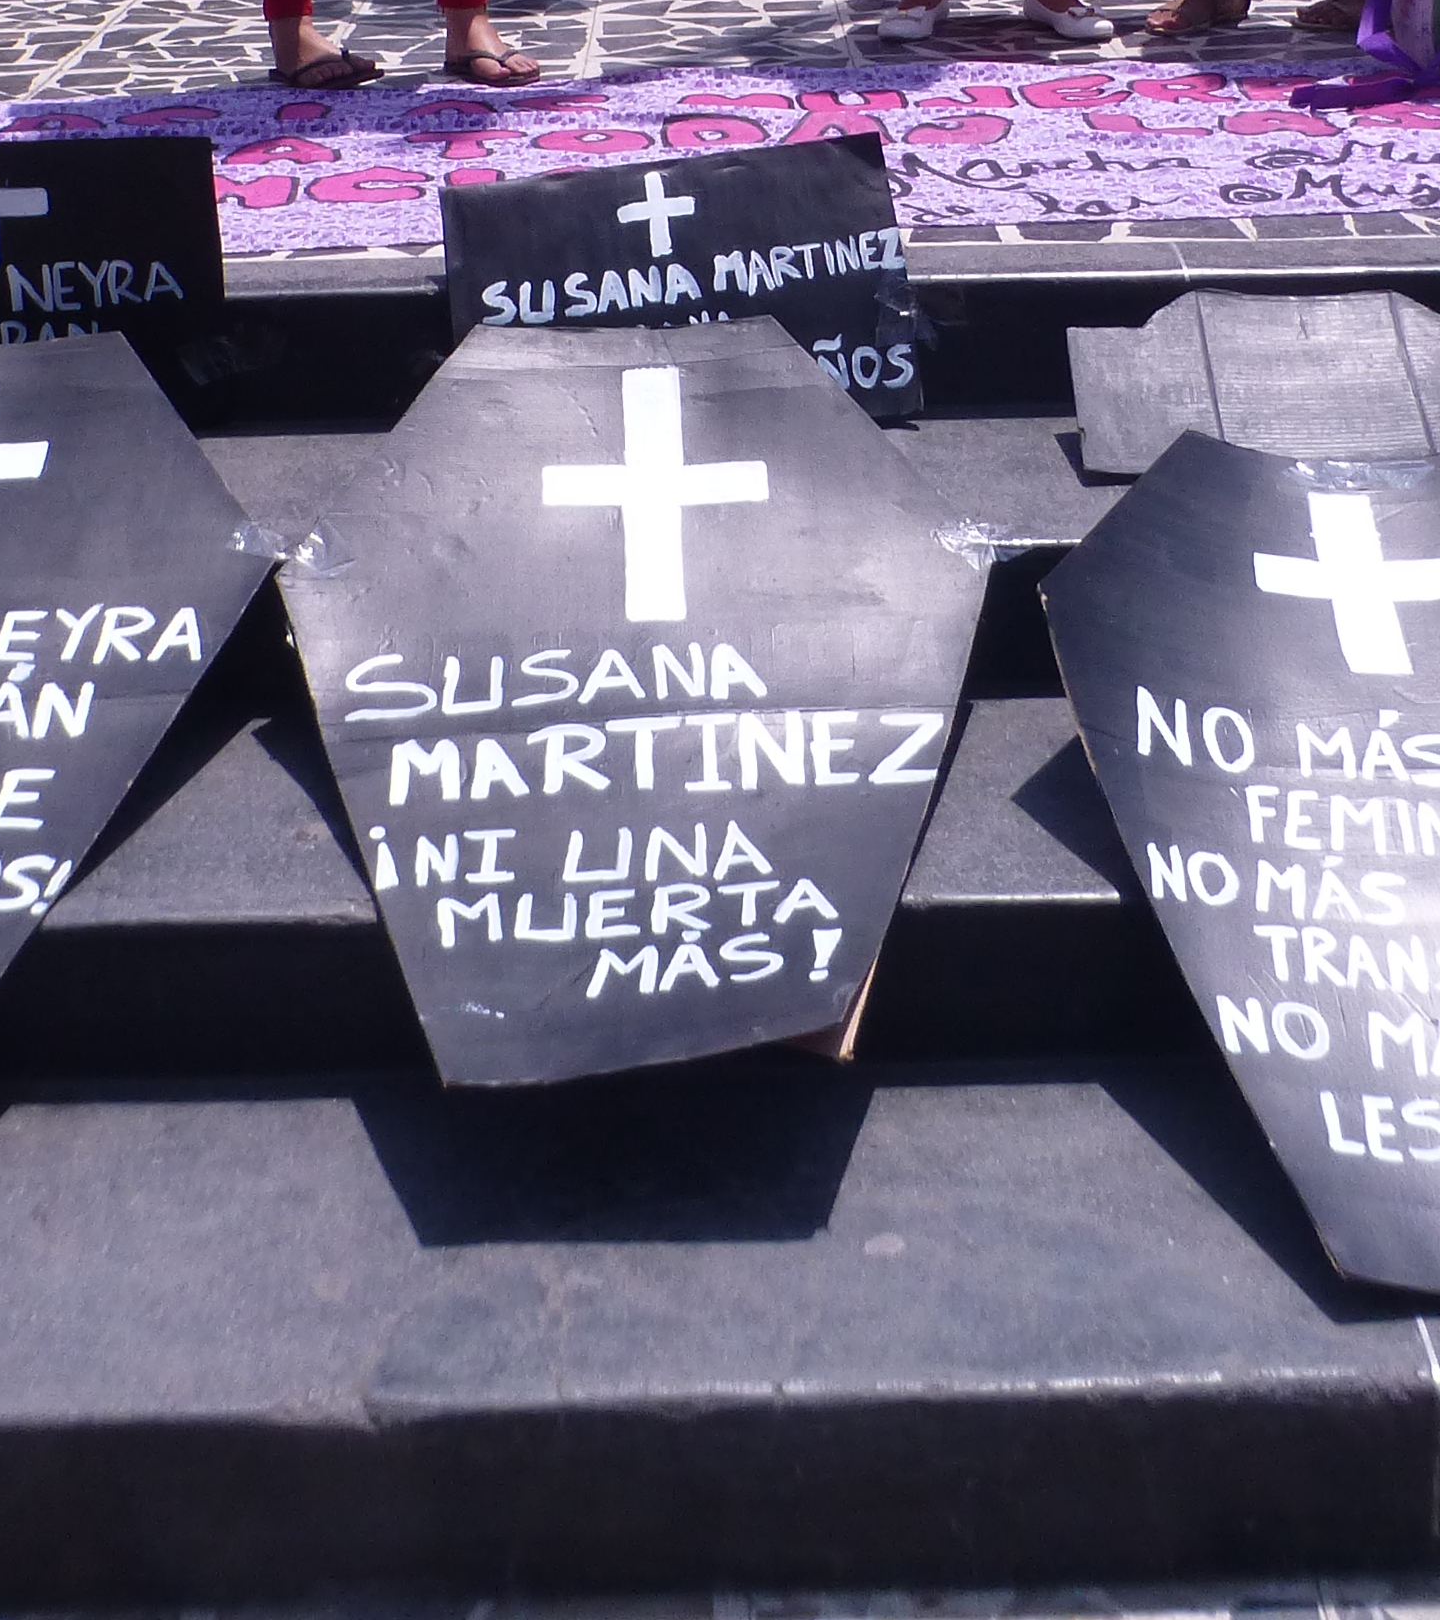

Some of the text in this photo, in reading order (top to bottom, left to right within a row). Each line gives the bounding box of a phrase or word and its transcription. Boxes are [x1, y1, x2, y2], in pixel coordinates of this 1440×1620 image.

[6, 259, 184, 314] NEYRA
[482, 226, 907, 326] SUSANA MARTINEZ
[344, 641, 768, 723] SUSANA
[389, 709, 945, 807] MARTINEZ
[1135, 684, 1255, 774] NO
[563, 819, 773, 883] UNA
[1147, 841, 1408, 926] NO MÁS
[436, 877, 839, 948] MUERTA
[1214, 994, 1330, 1061] NO
